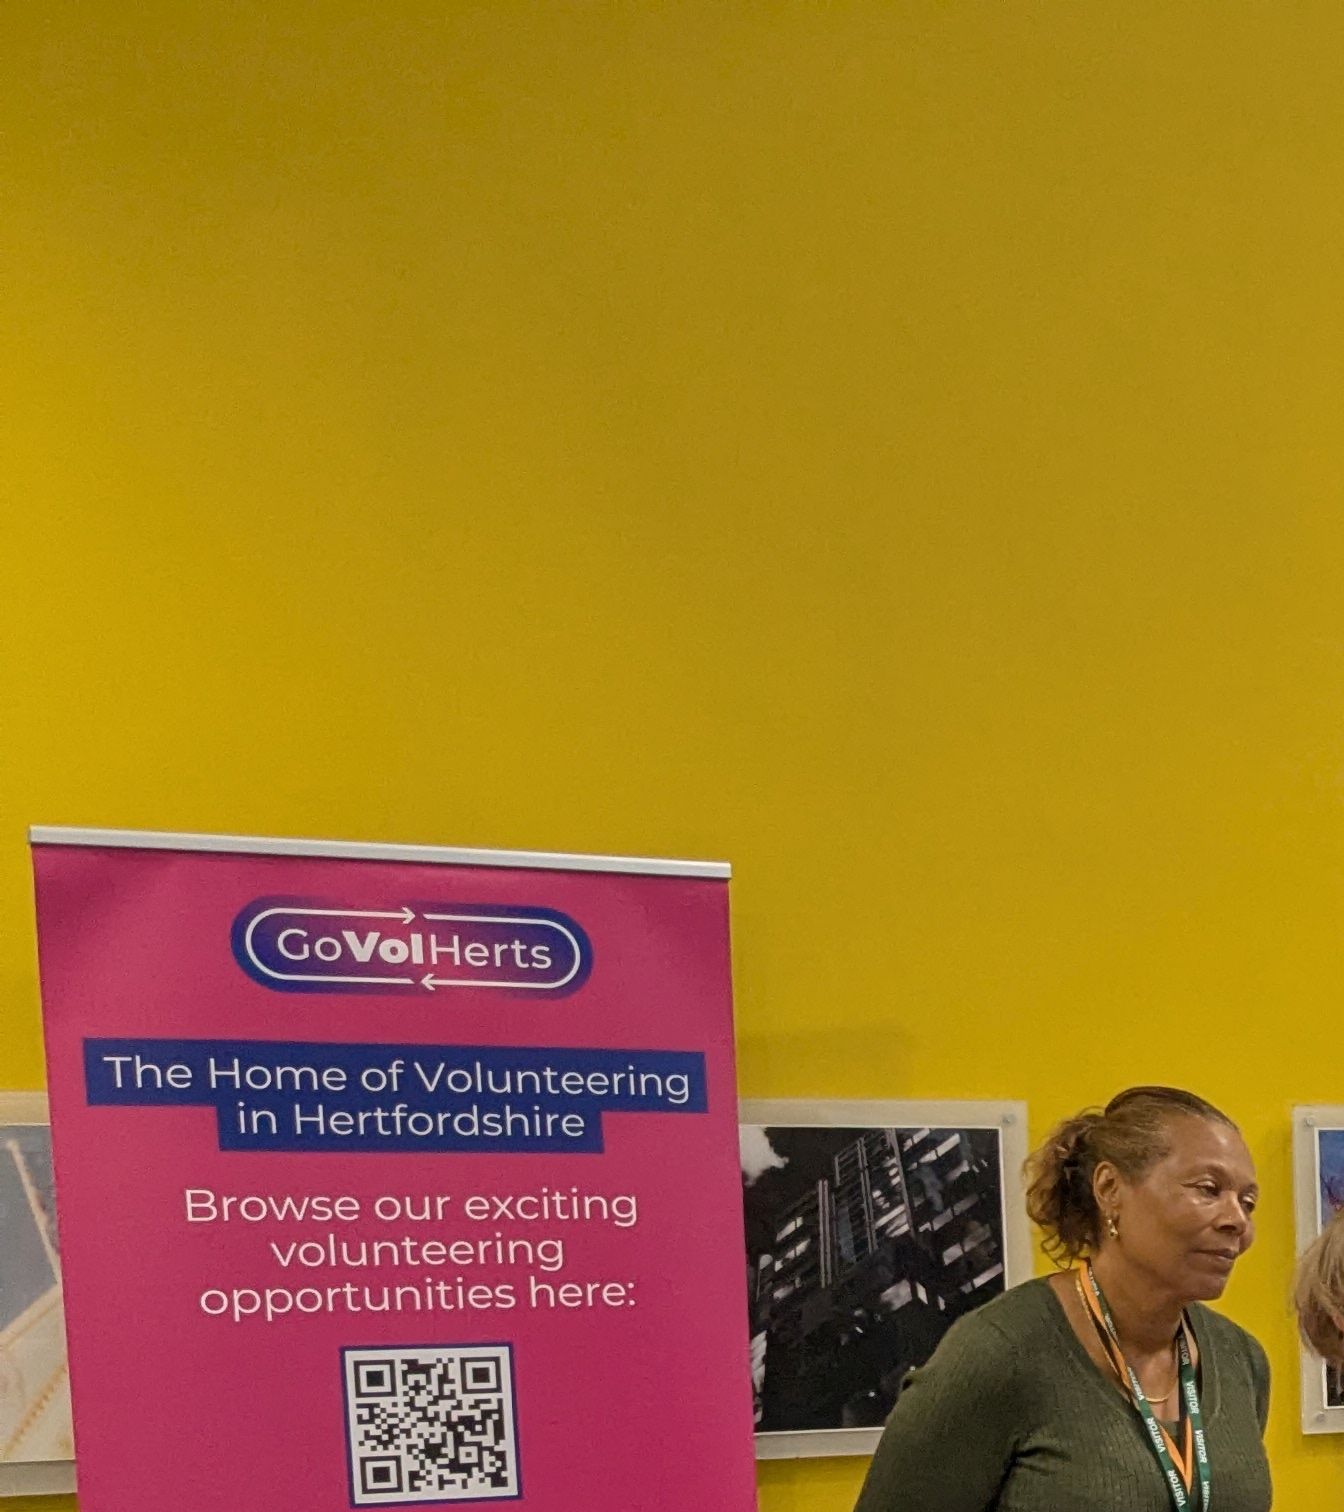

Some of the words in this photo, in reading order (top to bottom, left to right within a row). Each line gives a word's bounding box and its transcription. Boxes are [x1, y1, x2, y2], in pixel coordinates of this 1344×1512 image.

[276, 925, 553, 970] GoVolHerts
[103, 1055, 194, 1091] The
[208, 1059, 347, 1092] Home
[361, 1061, 405, 1094] of
[415, 1062, 690, 1102] Volunteering
[238, 1102, 278, 1135] in
[294, 1104, 586, 1139] Hertfordshire
[184, 1189, 361, 1222] Browse
[375, 1194, 450, 1221] our
[464, 1188, 639, 1228] exciting
[271, 1232, 565, 1270] volunteering
[199, 1278, 518, 1320] opportunities
[529, 1279, 636, 1309] here:
[1185, 1380, 1201, 1415] VISITOR
[1146, 1417, 1166, 1453] VISITOR
[1195, 1429, 1208, 1463] VISITOR
[1167, 1469, 1186, 1507] VISITOR
